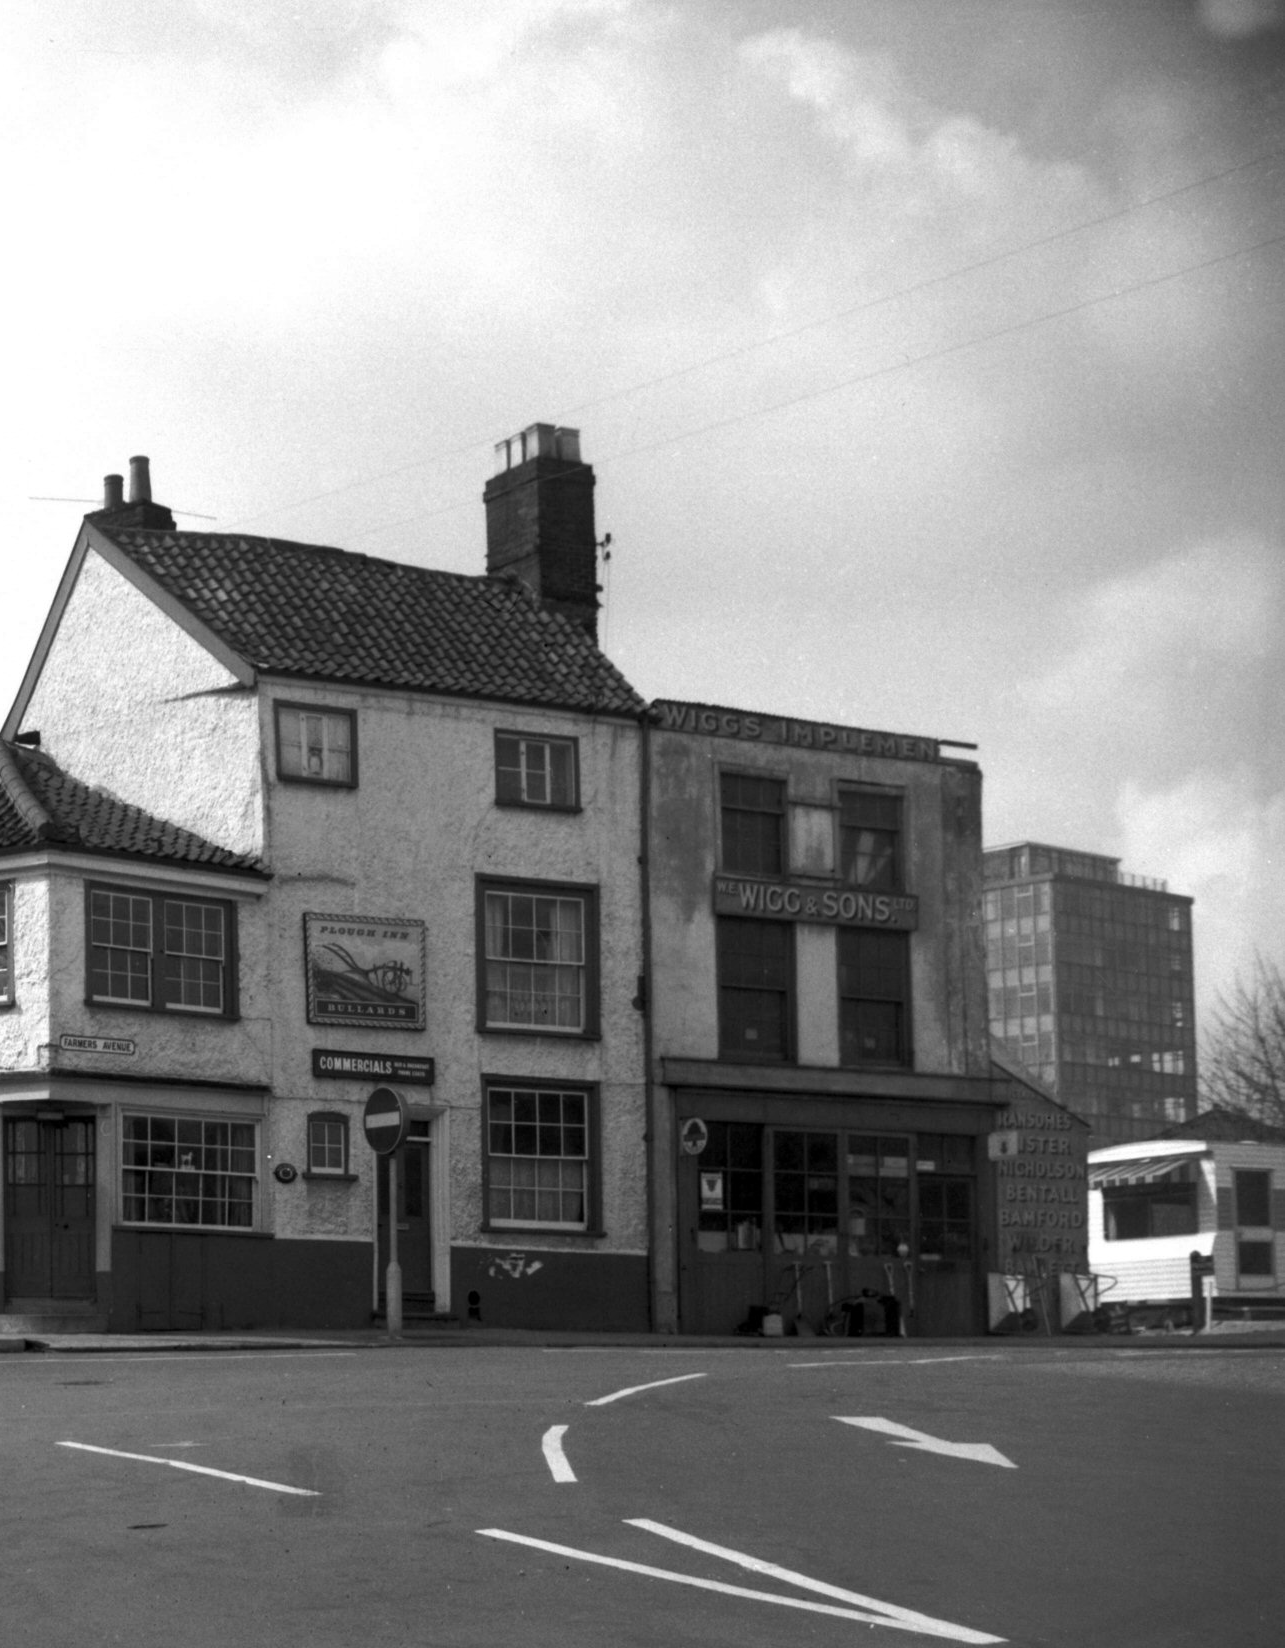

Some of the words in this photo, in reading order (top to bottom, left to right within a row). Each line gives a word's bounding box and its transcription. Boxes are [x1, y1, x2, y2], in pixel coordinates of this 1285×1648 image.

[664, 704, 762, 738] WIGGS
[781, 720, 936, 760] IMPLEMEN
[739, 883, 801, 913] WIGG
[806, 896, 818, 914] &
[320, 926, 377, 938] PLOUGH
[382, 931, 411, 941] INN
[327, 1003, 407, 1016] BULLARDS
[65, 1038, 98, 1049] FARMERS
[102, 1041, 132, 1052] AVENUE
[320, 1056, 393, 1075] COMMERCIALS
[998, 1112, 1072, 1130] RANSOMES
[1018, 1136, 1071, 1155] ISTER
[999, 1160, 1086, 1179] NICHOLSON
[1006, 1185, 1080, 1204] BENTALL
[1000, 1209, 1084, 1229] BAMFORD
